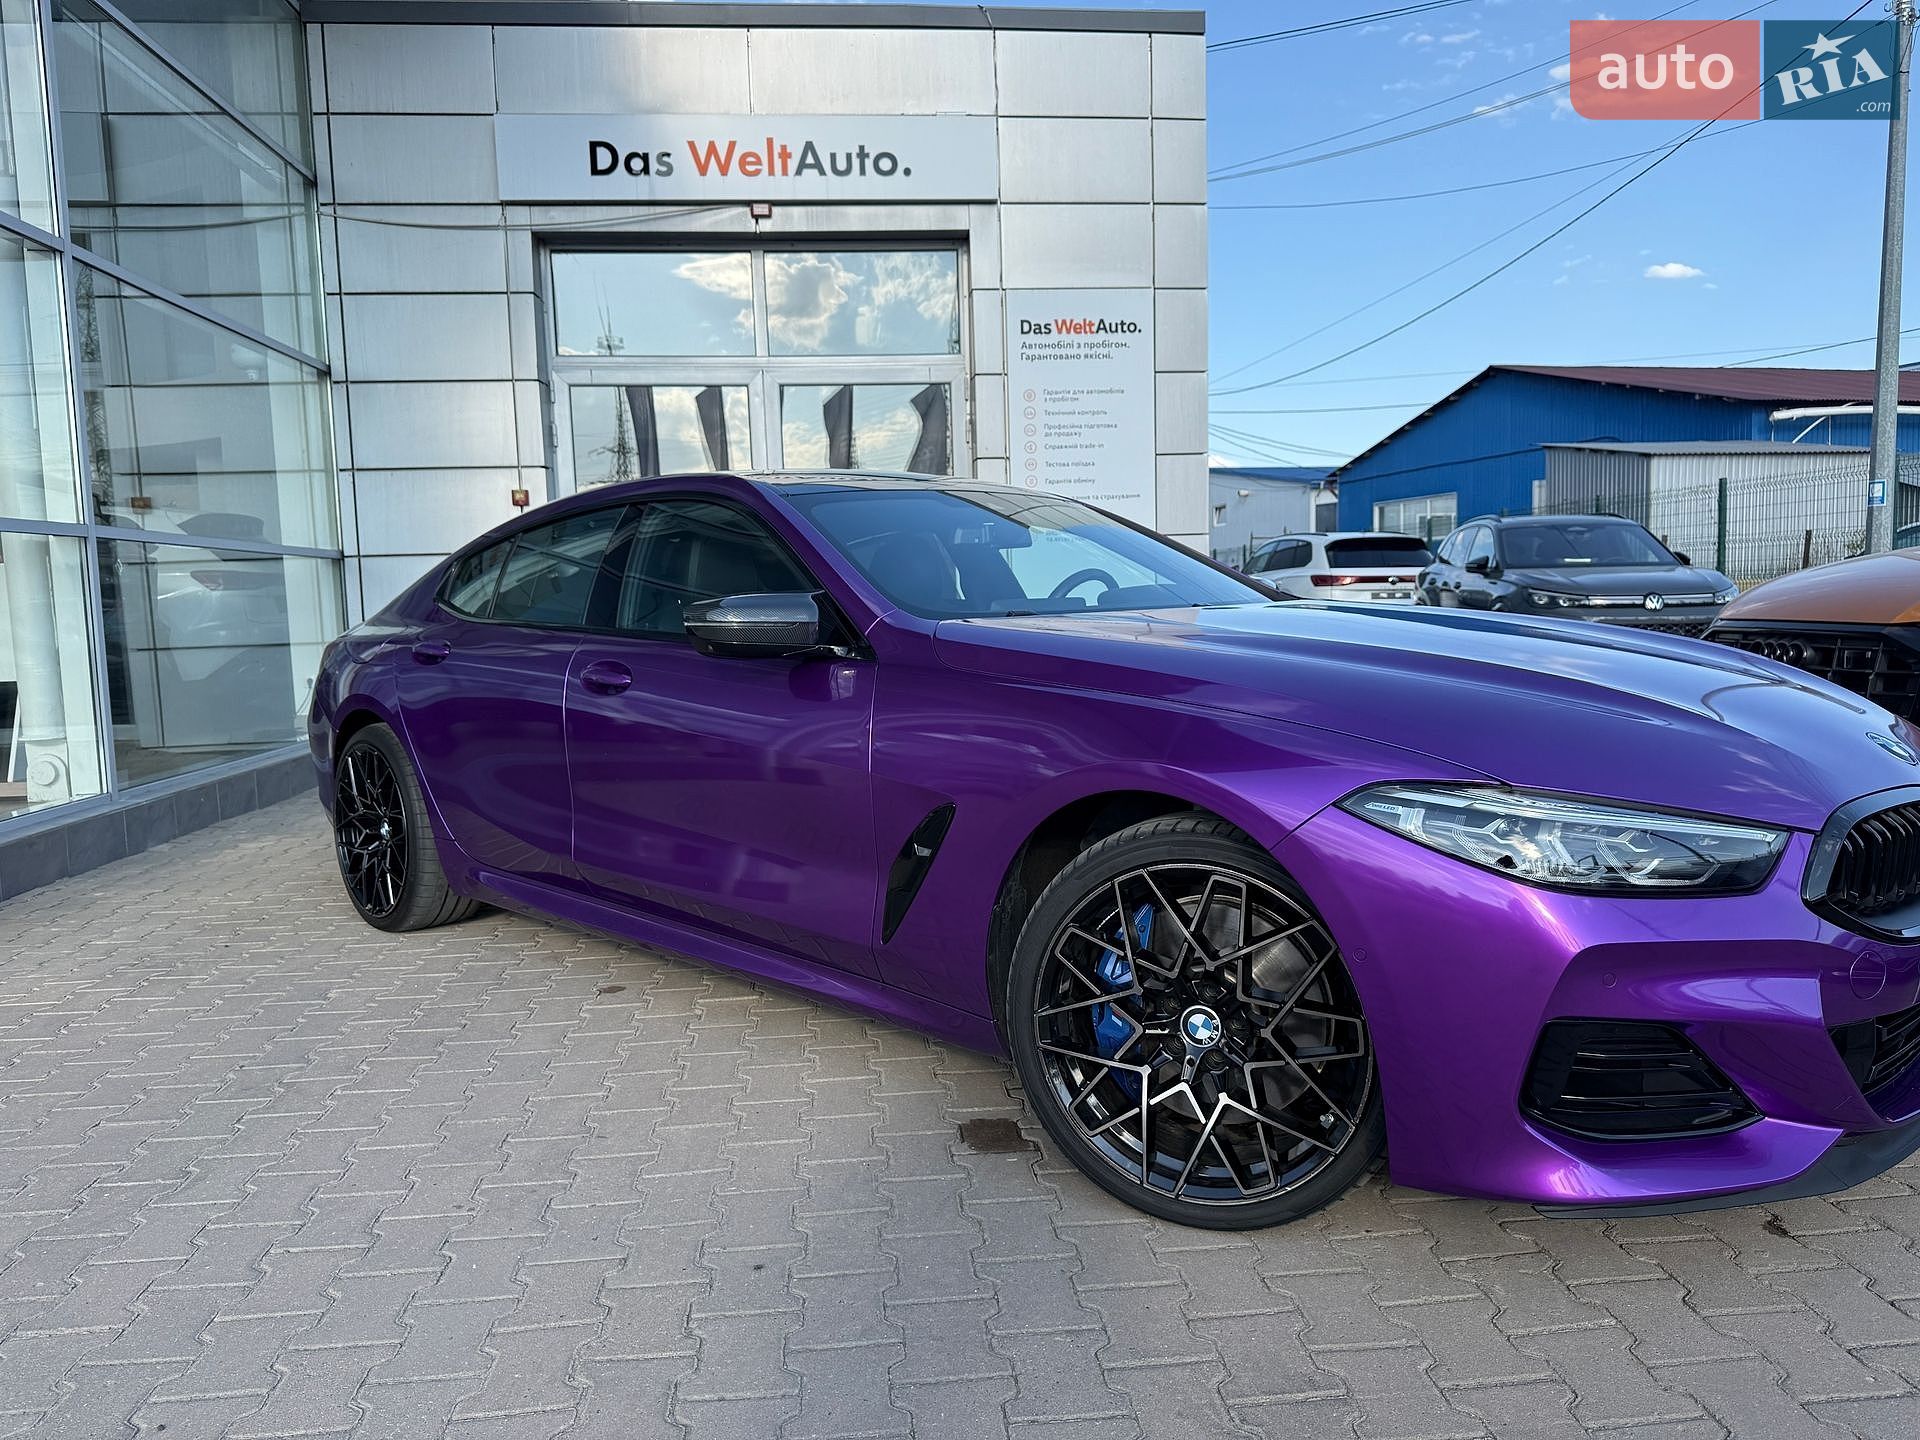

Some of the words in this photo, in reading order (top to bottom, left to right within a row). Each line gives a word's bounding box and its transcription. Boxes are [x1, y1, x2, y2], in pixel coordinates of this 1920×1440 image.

[588, 140, 674, 177] Das
[686, 137, 912, 177] WeltAuto.
[1020, 319, 1052, 335] Das
[1054, 318, 1142, 335] WeltAuto.
[1021, 340, 1074, 350] Автомобілі
[1083, 340, 1130, 350] пробігом.
[1020, 352, 1081, 362] Гарантовано
[1083, 351, 1113, 360] якісні.
